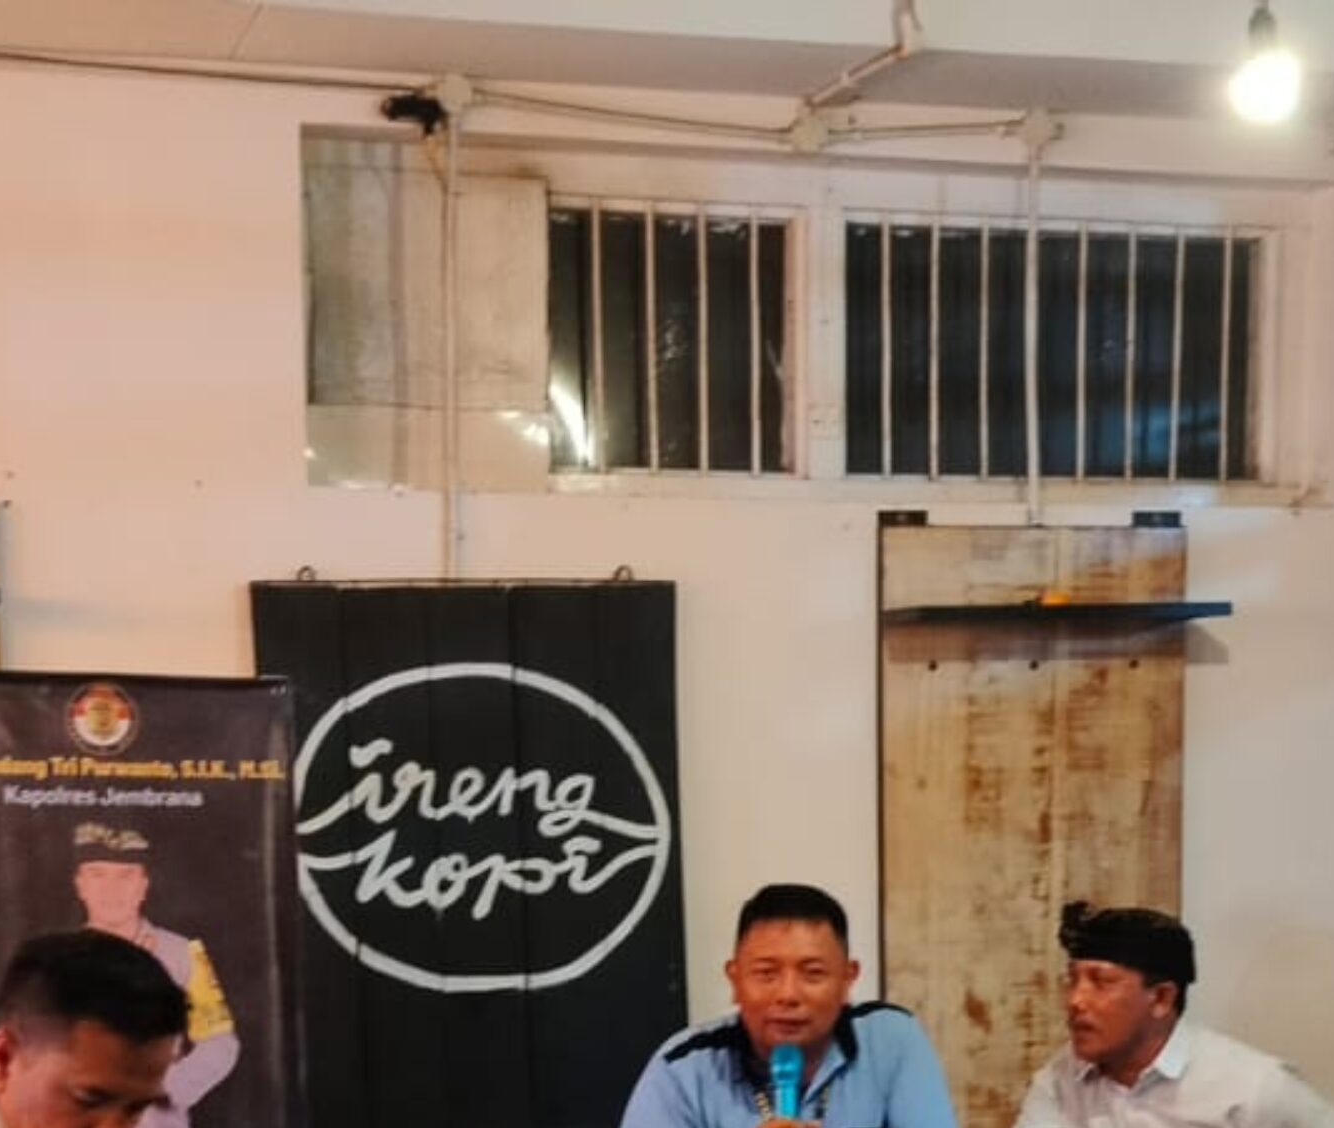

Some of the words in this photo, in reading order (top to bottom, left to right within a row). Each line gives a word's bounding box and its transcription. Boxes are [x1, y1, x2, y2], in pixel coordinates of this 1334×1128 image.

[49, 757, 78, 776] Tri
[332, 737, 612, 838] ireng
[3, 784, 97, 809] Kapolres
[100, 787, 204, 807] Jembrana
[339, 830, 629, 921] kopi
